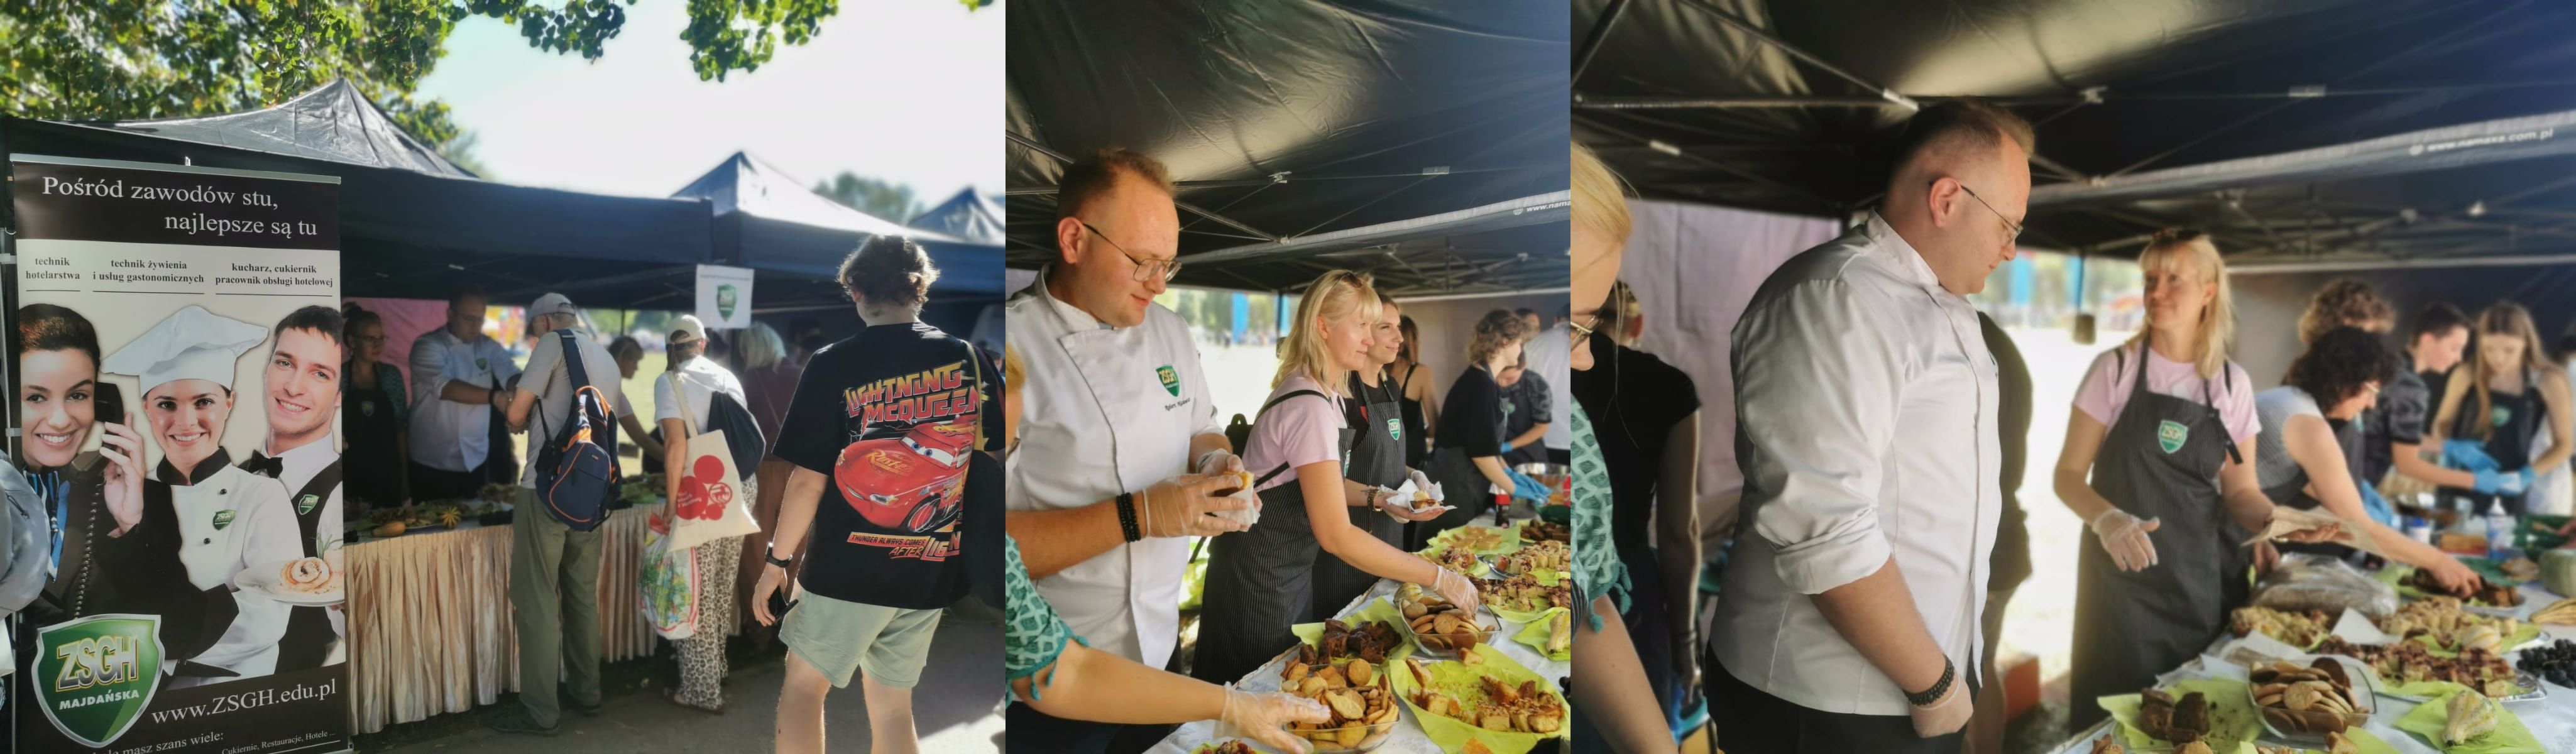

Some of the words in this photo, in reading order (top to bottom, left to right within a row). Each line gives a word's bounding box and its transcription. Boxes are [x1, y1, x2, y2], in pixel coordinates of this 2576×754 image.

[42, 177, 124, 198] Pośród
[131, 185, 236, 204] zawodów
[243, 191, 278, 210] stu,
[165, 212, 264, 236] najlepsze
[271, 222, 292, 239] są
[298, 221, 317, 236] tu
[35, 257, 70, 266] technik
[111, 260, 145, 268] technik
[148, 260, 187, 270] żywienia
[232, 263, 272, 273] kucharz,
[275, 265, 317, 273] cukiernik
[26, 271, 80, 280] hotelarstwa
[93, 272, 96, 280] i
[99, 272, 124, 282] usług
[127, 273, 204, 284] gastonomicznych
[216, 276, 261, 285] pracownik
[263, 277, 292, 287] obsługi
[295, 277, 332, 287] hotelowej
[845, 361, 962, 418] LIGHTNING
[851, 534, 877, 543] THUNDER
[879, 537, 903, 545] ALWAYS
[889, 546, 924, 557] AFTER
[56, 635, 139, 692] ZSGH
[59, 689, 140, 710] MAJDAŃSKA
[151, 678, 336, 724] www.ZSGH.edu.pl
[156, 739, 187, 751] szans
[190, 731, 224, 745] wiele:
[222, 744, 260, 754] Cukiernie,
[261, 735, 304, 748] Restauracje,
[305, 731, 328, 740] Hotele
